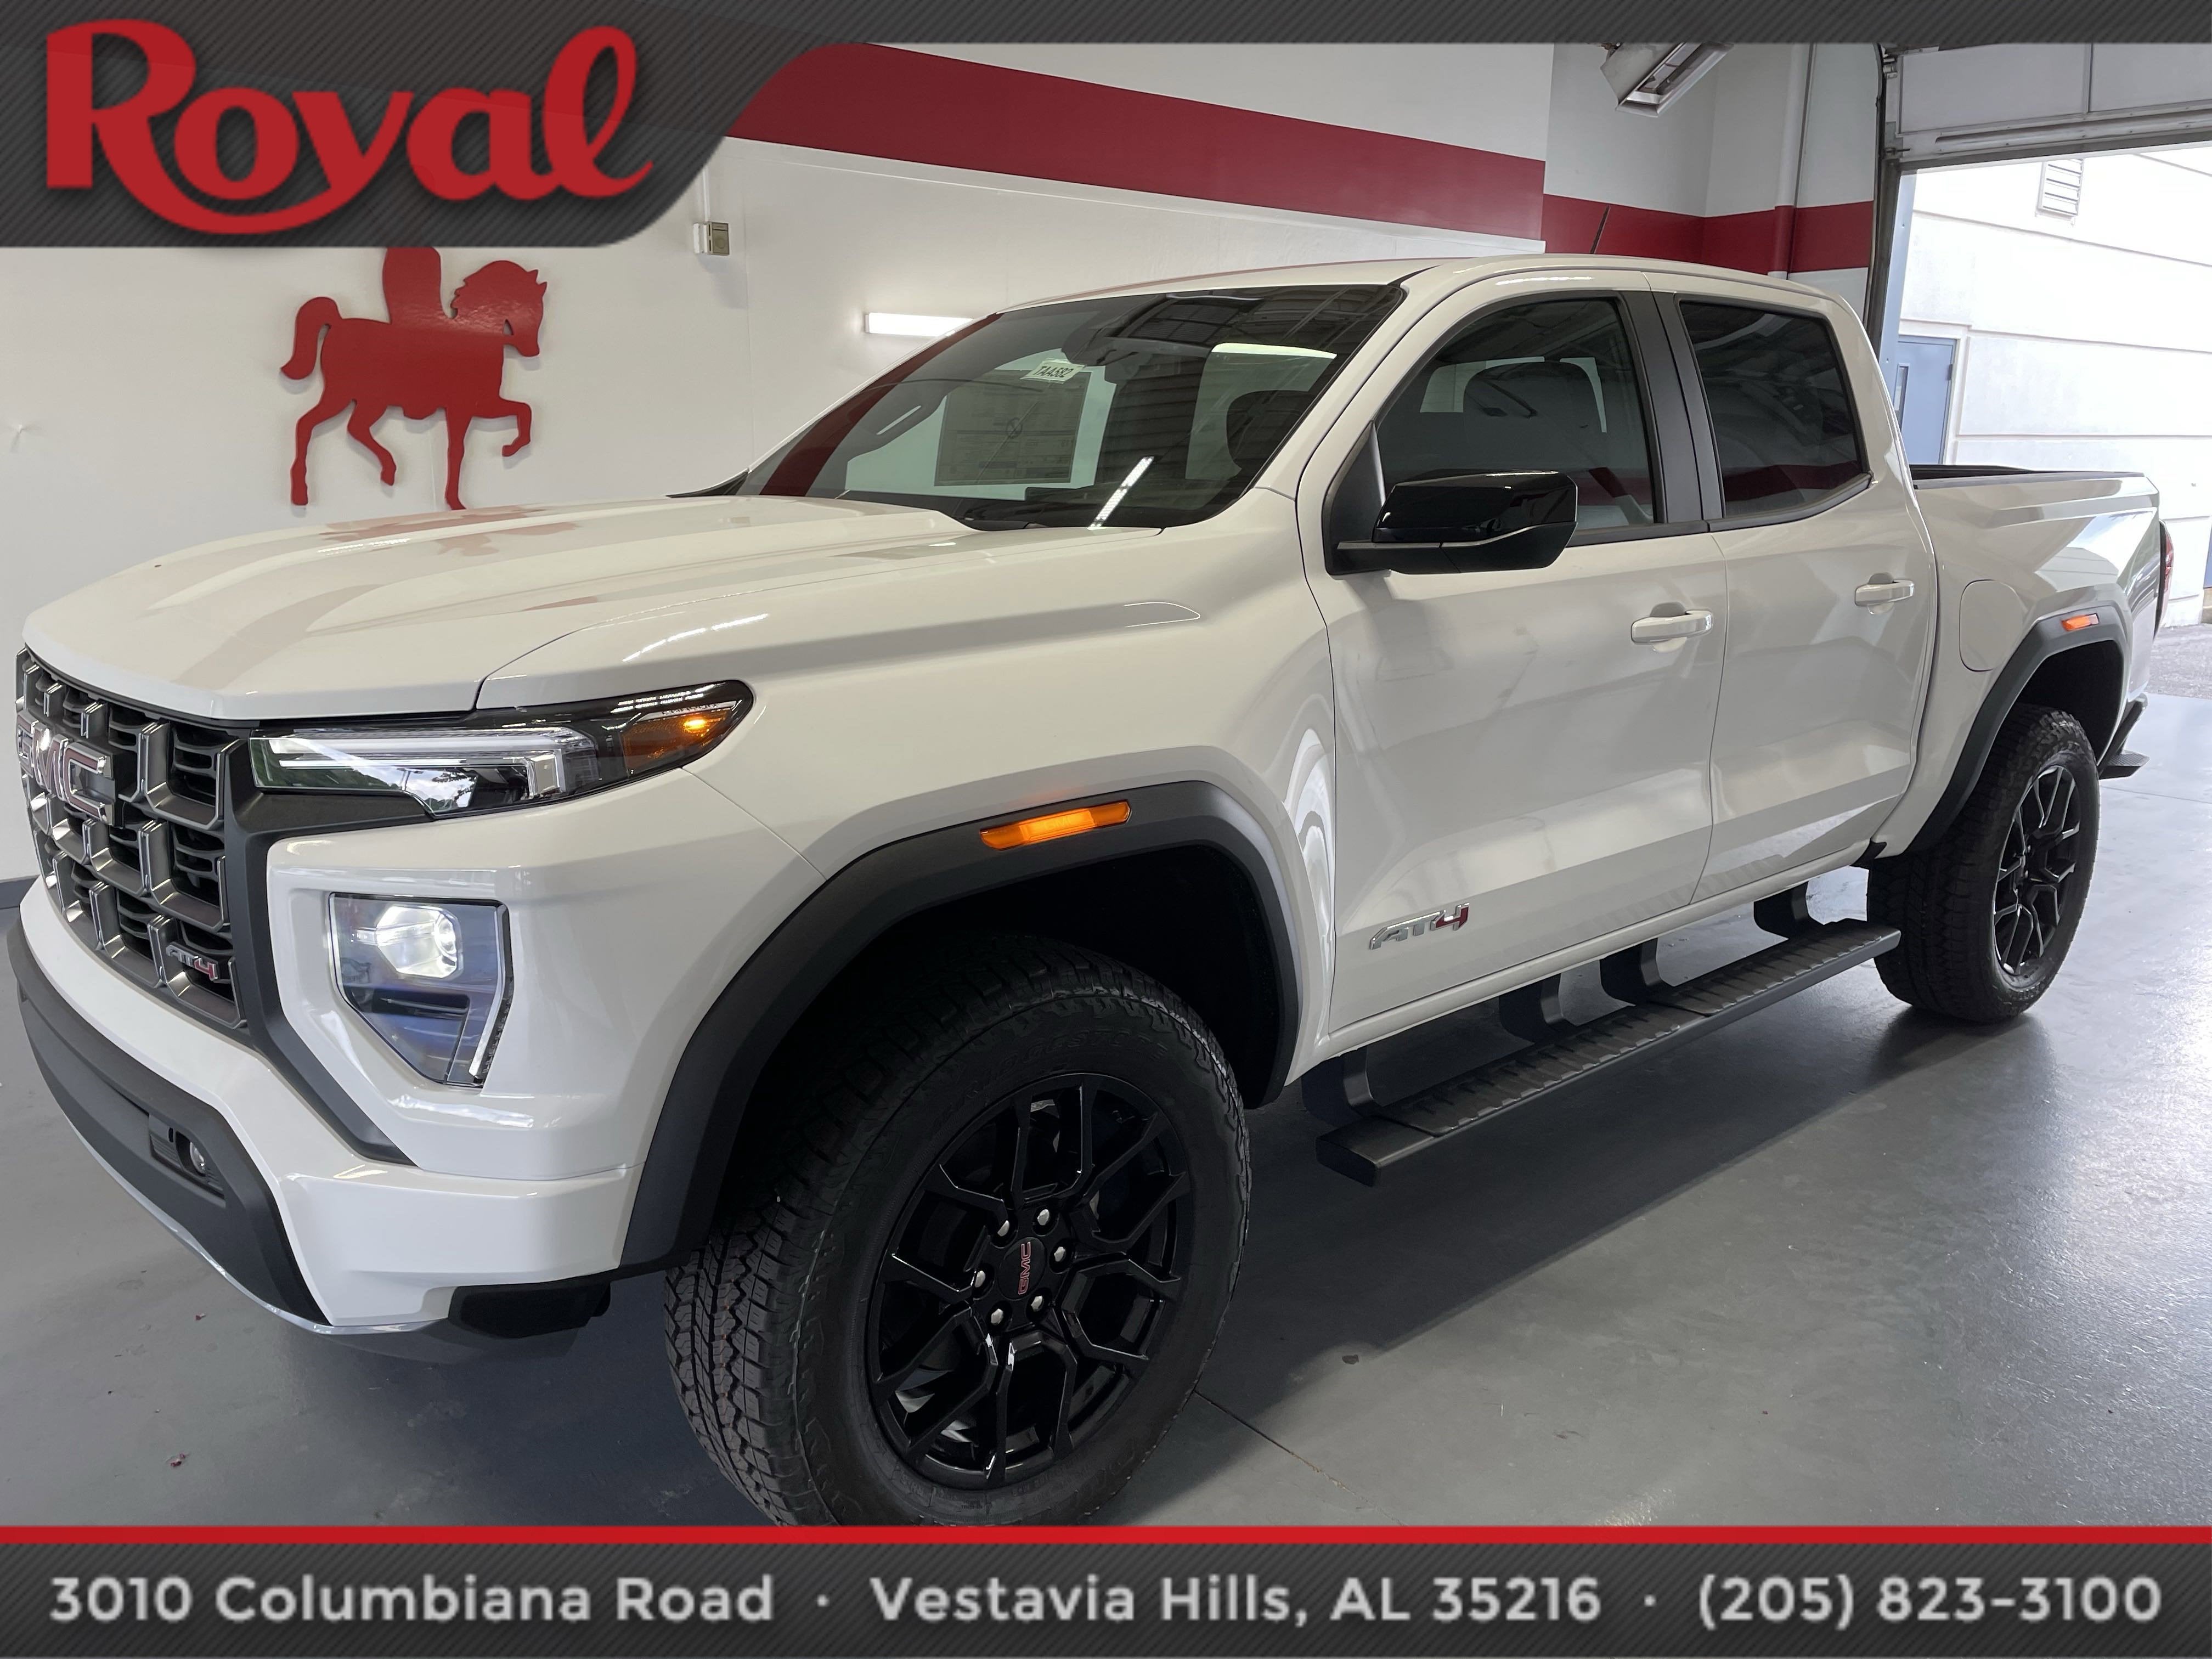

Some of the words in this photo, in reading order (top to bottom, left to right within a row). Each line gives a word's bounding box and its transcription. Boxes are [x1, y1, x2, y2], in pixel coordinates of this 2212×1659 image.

[16, 711, 114, 825] GMC
[1369, 902, 1470, 950] AT4
[166, 941, 218, 981] AT4
[1018, 1242, 1031, 1295] GMC
